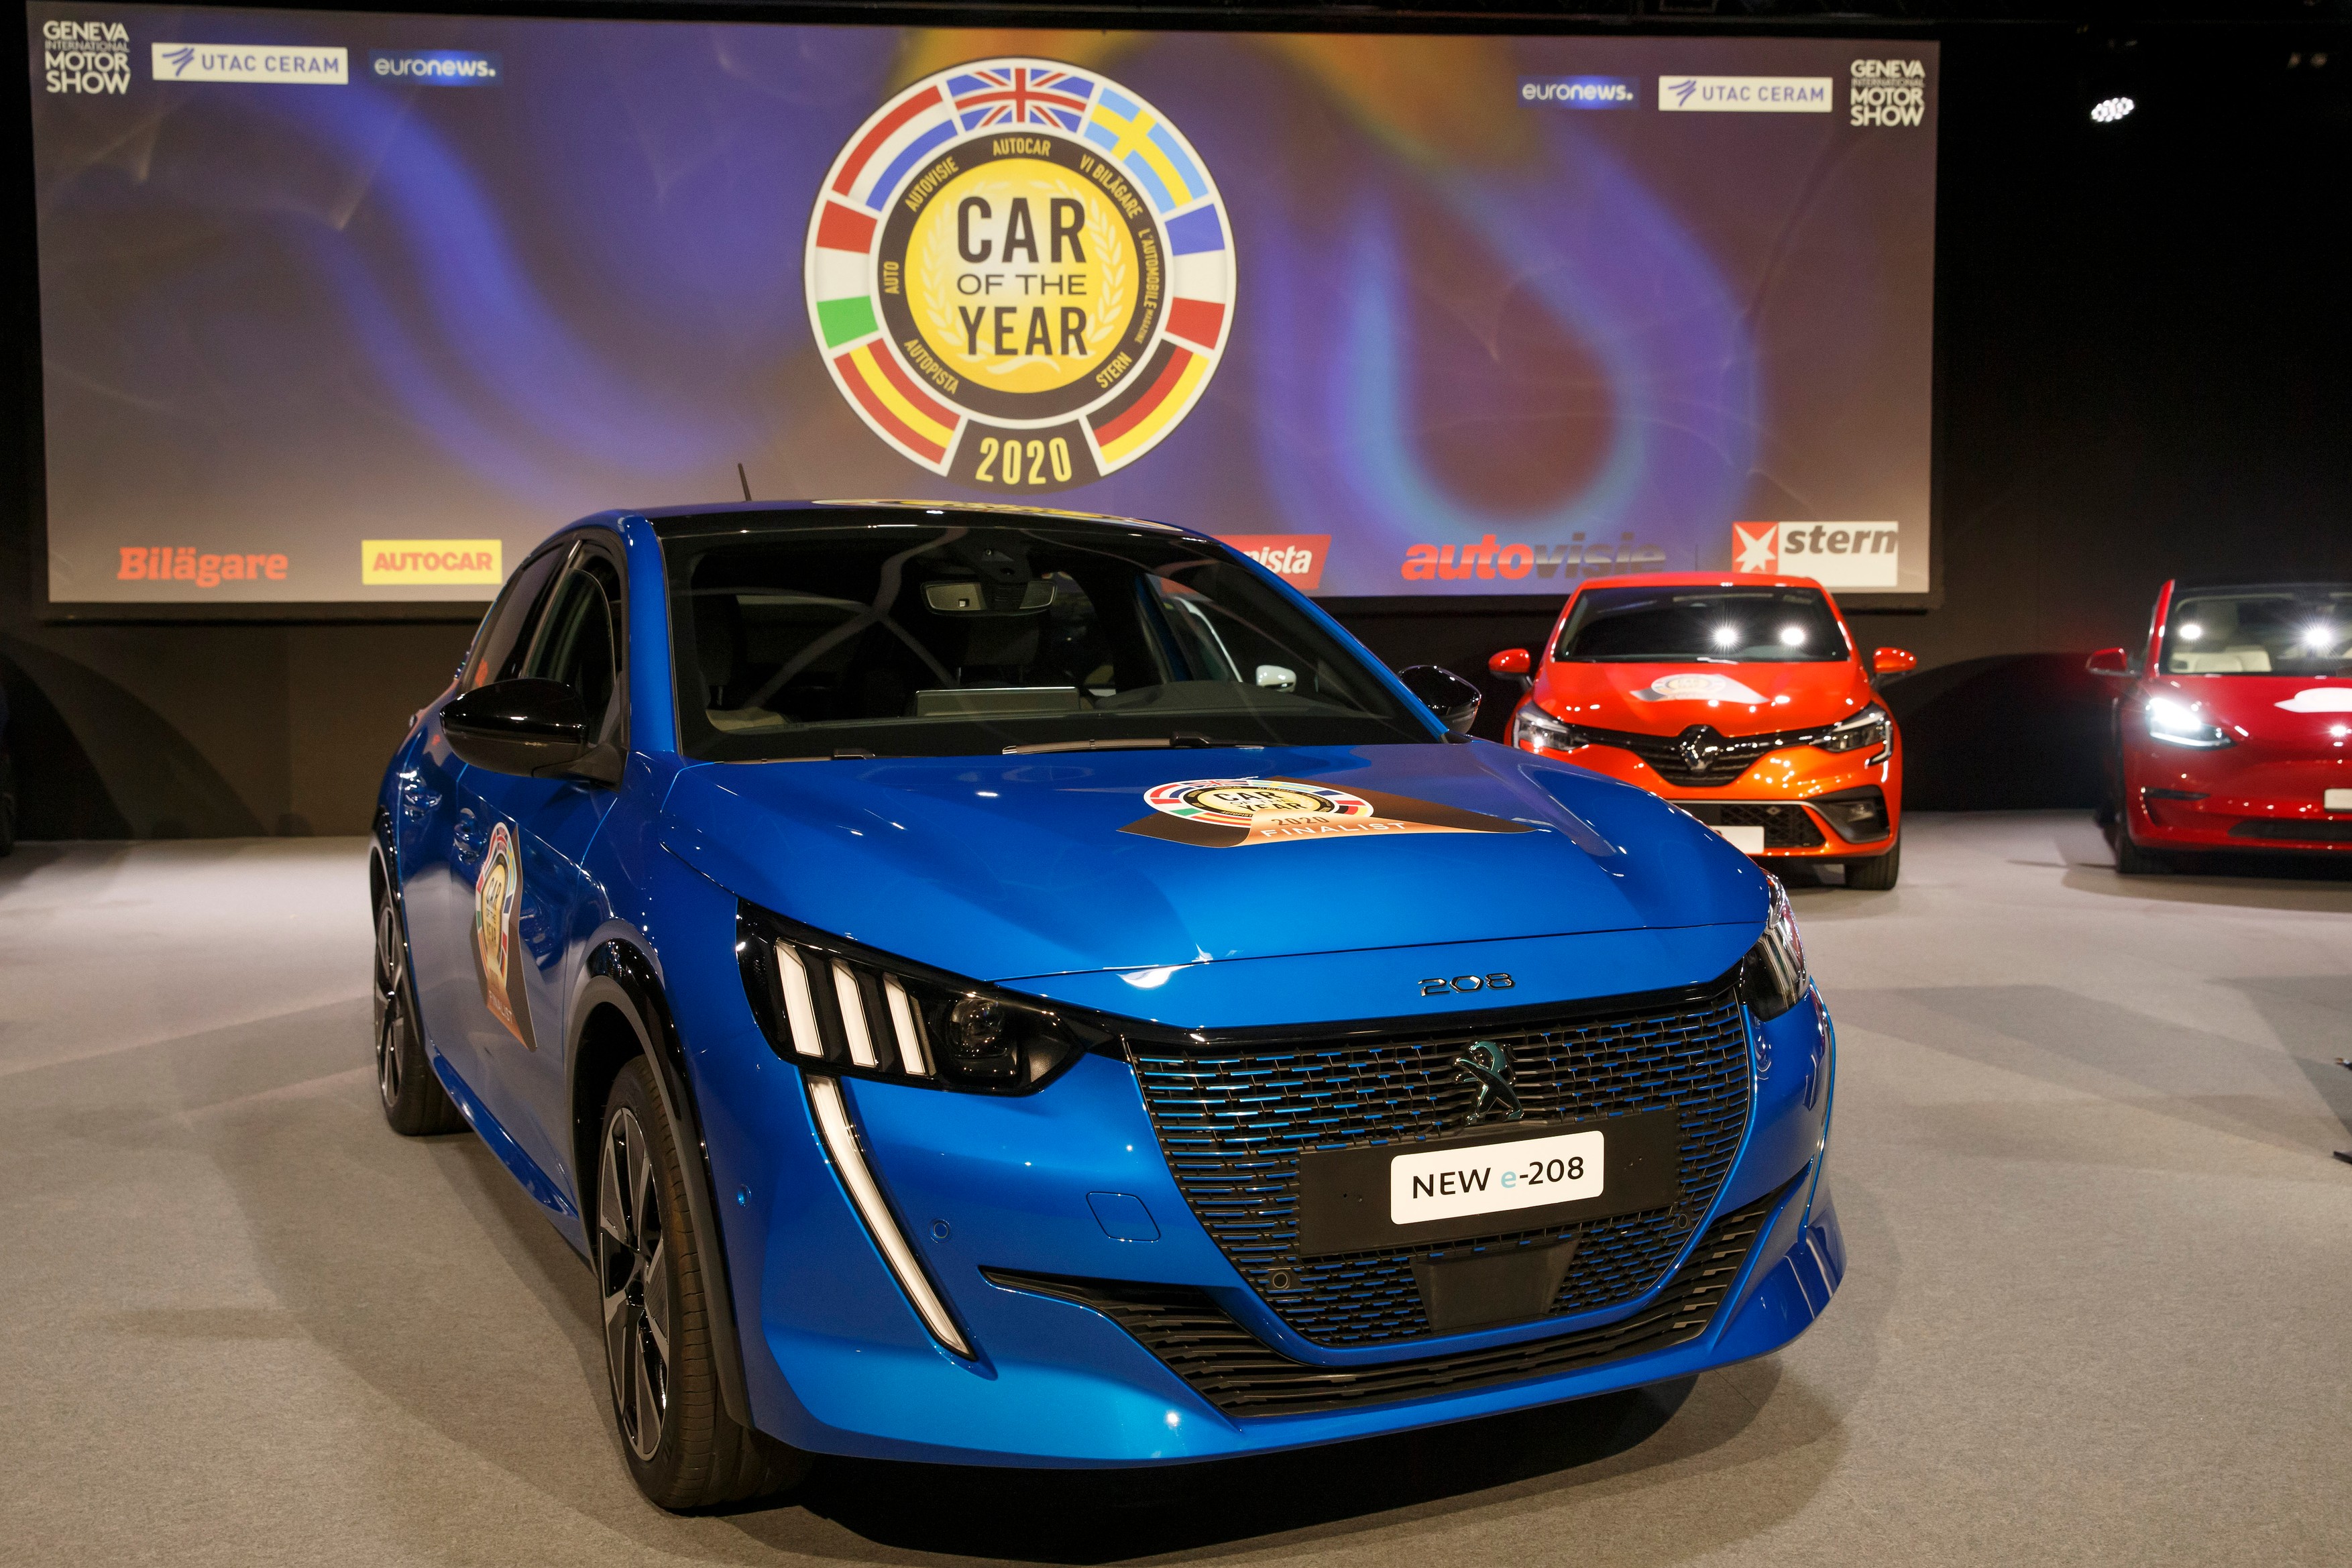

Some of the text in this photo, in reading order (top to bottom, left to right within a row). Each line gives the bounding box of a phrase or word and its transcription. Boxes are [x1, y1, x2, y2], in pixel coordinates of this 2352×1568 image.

[43, 20, 129, 42] GENEVA
[45, 40, 130, 53] INTERNATIONAL
[45, 50, 131, 72] MOTOR
[202, 54, 339, 74] UTAC CERAM
[1850, 59, 1925, 78] GENEVA
[46, 70, 131, 94] SHOW
[1702, 85, 1825, 103] UTAC CERAM
[1850, 87, 1925, 107] MOTOR
[1850, 105, 1925, 127] SHOW
[993, 137, 1051, 156] AUTOCAR
[905, 156, 959, 213] AUTOVISIE
[1080, 154, 1143, 219] VI BILÄGARE
[958, 196, 1087, 264] CAR
[884, 261, 900, 294] AUTO
[957, 274, 1087, 295] OF THE
[958, 306, 1088, 356] YEAR
[904, 339, 960, 394] AUTOPISTA
[1096, 351, 1133, 388] STERN
[975, 437, 1072, 485] 2020
[1785, 525, 1899, 555] stern
[372, 552, 493, 571] AUTOCAR
[1401, 532, 1666, 580] autovisie
[117, 547, 289, 588] Bilägare
[1213, 791, 1284, 801] CAR
[1237, 802, 1308, 812] YEAR
[1260, 822, 1406, 838] FINALIST
[1272, 816, 1329, 826] 2020
[1418, 972, 1516, 997] 208
[1412, 1156, 1585, 1199] NEW e-208
